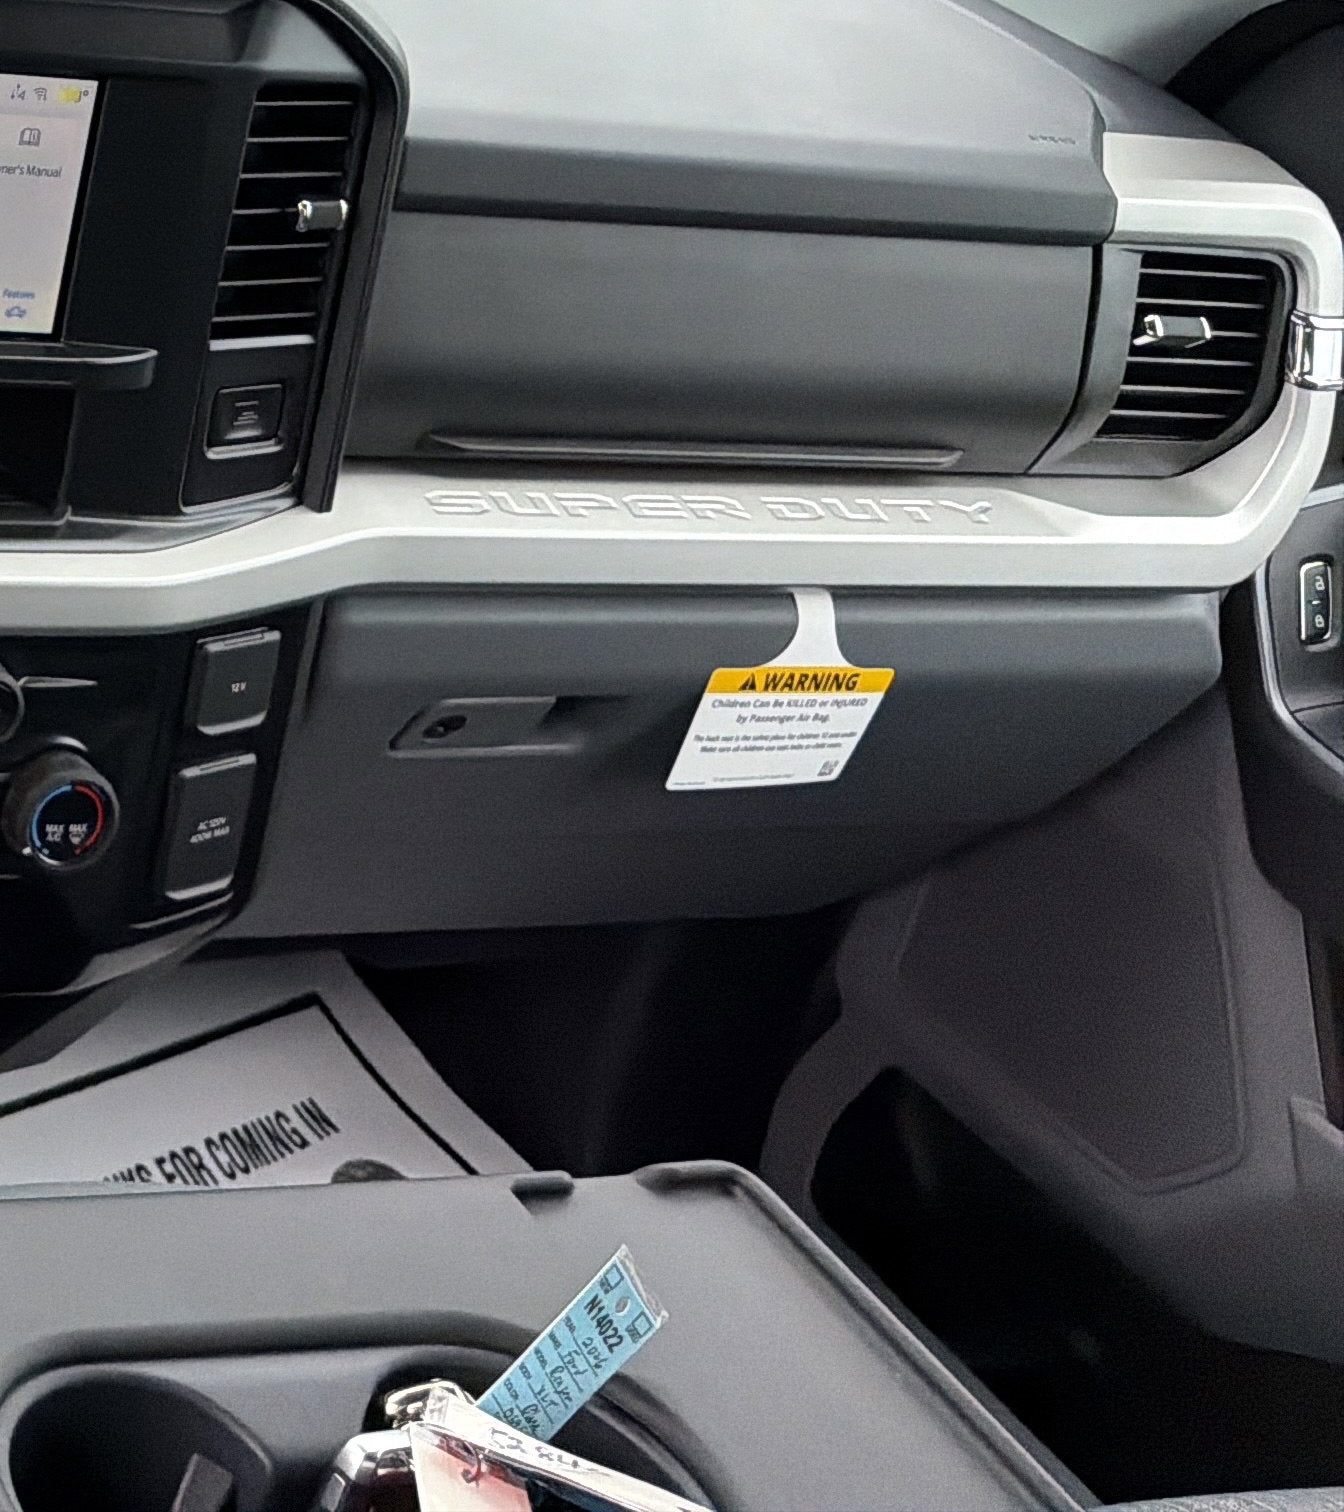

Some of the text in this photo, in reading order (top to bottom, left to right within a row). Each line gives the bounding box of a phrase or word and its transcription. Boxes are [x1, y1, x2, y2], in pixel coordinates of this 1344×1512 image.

[26, 163, 62, 178] Manual
[423, 488, 994, 525] SUPER DUTY
[762, 672, 861, 692] WARNING
[711, 697, 868, 709] Children Can Be KILLED or INJURED
[736, 714, 747, 725] by
[749, 713, 796, 725] Passenger
[797, 712, 811, 722] Air
[45, 823, 65, 833] MAX
[68, 823, 88, 833] MAX
[155, 1145, 220, 1186] FOR
[204, 1109, 312, 1181] COMING
[292, 1096, 341, 1141] IN
[583, 1292, 624, 1355] N14022
